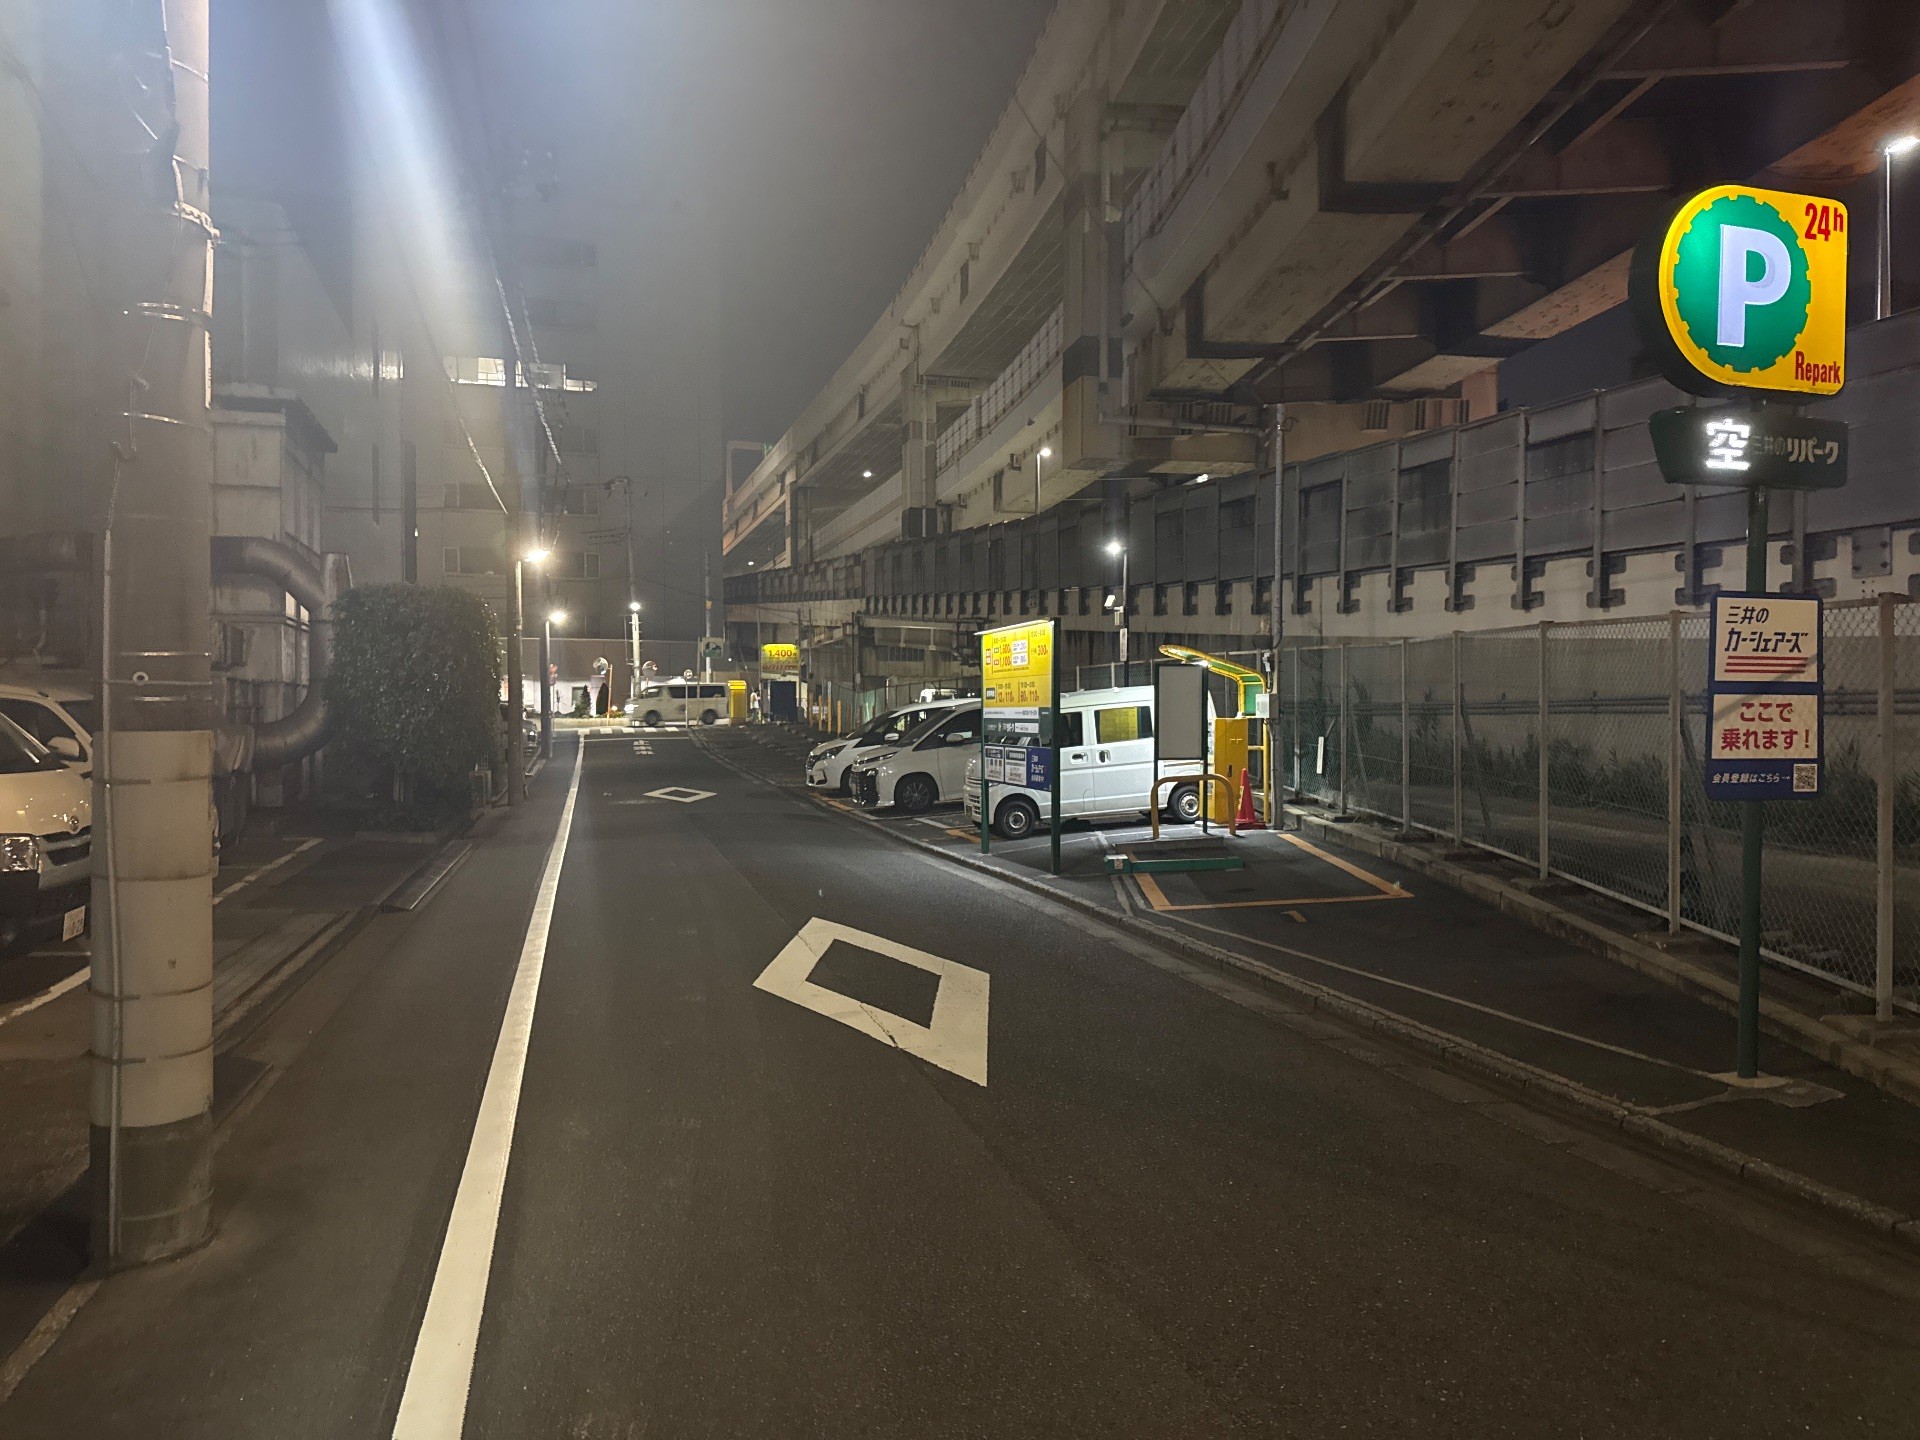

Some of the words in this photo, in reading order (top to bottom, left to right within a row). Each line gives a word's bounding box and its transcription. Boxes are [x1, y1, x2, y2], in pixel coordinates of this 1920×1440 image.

[1804, 202, 1844, 242] 24h
[1716, 223, 1792, 348] P
[1794, 350, 1841, 387] Repark
[1705, 418, 1752, 471] 空
[1725, 606, 1769, 625] 三井の
[1724, 627, 1809, 653] カーシェアーズ
[1739, 702, 1794, 722] ここで
